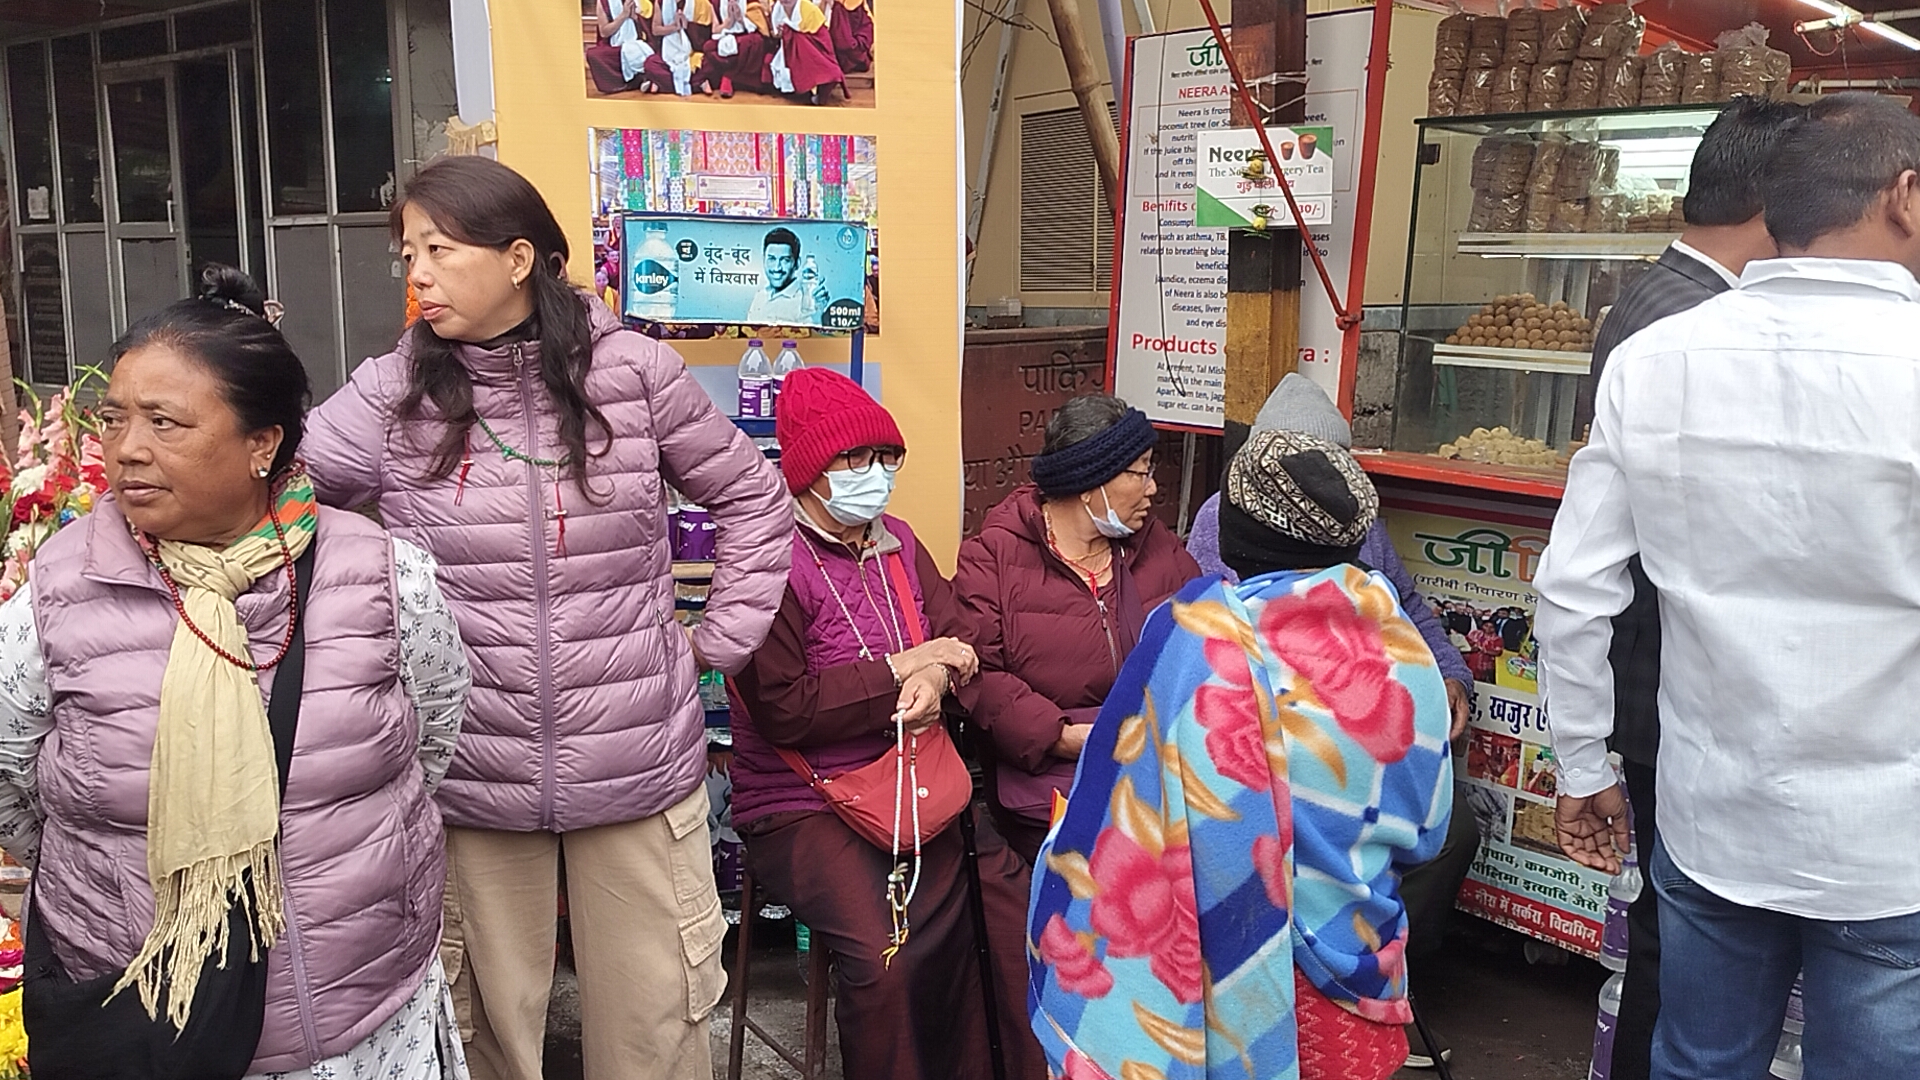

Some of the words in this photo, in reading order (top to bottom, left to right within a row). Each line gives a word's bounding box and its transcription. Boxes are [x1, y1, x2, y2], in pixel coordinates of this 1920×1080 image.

[1178, 86, 1217, 99] NEERA
[1203, 108, 1209, 116] is
[1159, 123, 1189, 131] coconut
[1208, 119, 1219, 128] (or
[1171, 134, 1195, 142] nutrit
[1164, 147, 1182, 156] juice
[1172, 158, 1184, 166] off
[1208, 167, 1227, 178] The
[1306, 164, 1324, 174] Tea
[1174, 182, 1181, 190] it
[1142, 200, 1187, 212] Benifits
[1159, 218, 1194, 228] Consumpt
[1140, 232, 1158, 241] fever
[1159, 232, 1175, 241] such
[1185, 233, 1214, 242] asthma,
[1165, 247, 1173, 255] to
[1175, 246, 1208, 257] breathing
[694, 267, 706, 284] में
[709, 267, 760, 286] विश्वास
[1188, 276, 1215, 284] eczema
[1164, 289, 1172, 298] of
[1174, 289, 1194, 298] Neera
[1196, 290, 1202, 298] is
[1203, 290, 1218, 299] also
[829, 306, 861, 317] 500ml
[1171, 303, 1204, 313] diseases,
[1205, 305, 1221, 313] liver
[1186, 319, 1199, 327] and
[1201, 321, 1214, 329] eye
[1132, 334, 1217, 355] Products
[1156, 362, 1165, 370] At
[1196, 365, 1207, 374] Tal
[1183, 376, 1189, 384] is
[1190, 376, 1202, 386] the
[1203, 378, 1222, 387] main
[1156, 387, 1176, 396] Apart
[1157, 400, 1176, 409] sugar
[1177, 402, 1190, 410] etc.
[1205, 404, 1214, 412] be
[1524, 859, 1586, 890] कमजोरी,
[1522, 878, 1570, 902] इत्यादि
[1572, 892, 1600, 912] जैसे
[1499, 895, 1511, 914] में
